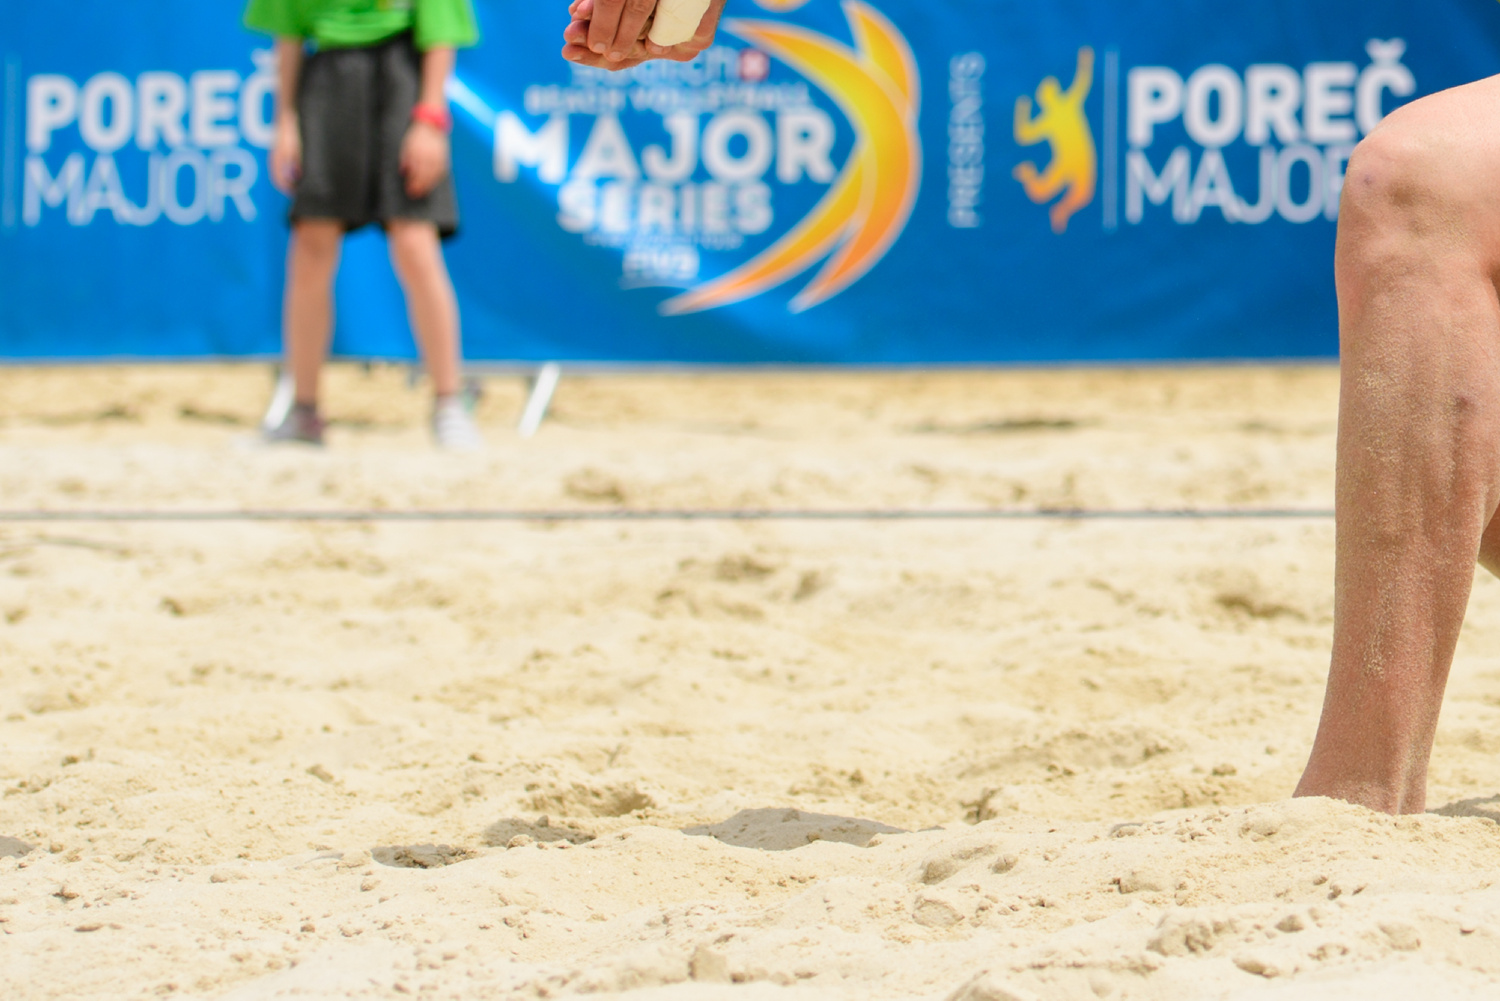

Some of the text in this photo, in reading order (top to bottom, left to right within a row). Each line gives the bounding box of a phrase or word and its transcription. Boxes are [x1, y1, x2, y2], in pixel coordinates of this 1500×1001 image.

[25, 47, 281, 153] POREČ
[1126, 36, 1417, 149] POREČ
[493, 107, 838, 185] MAJOR
[947, 50, 987, 228] PRESENTS
[22, 149, 259, 227] MAJOR
[556, 174, 775, 236] SERIES
